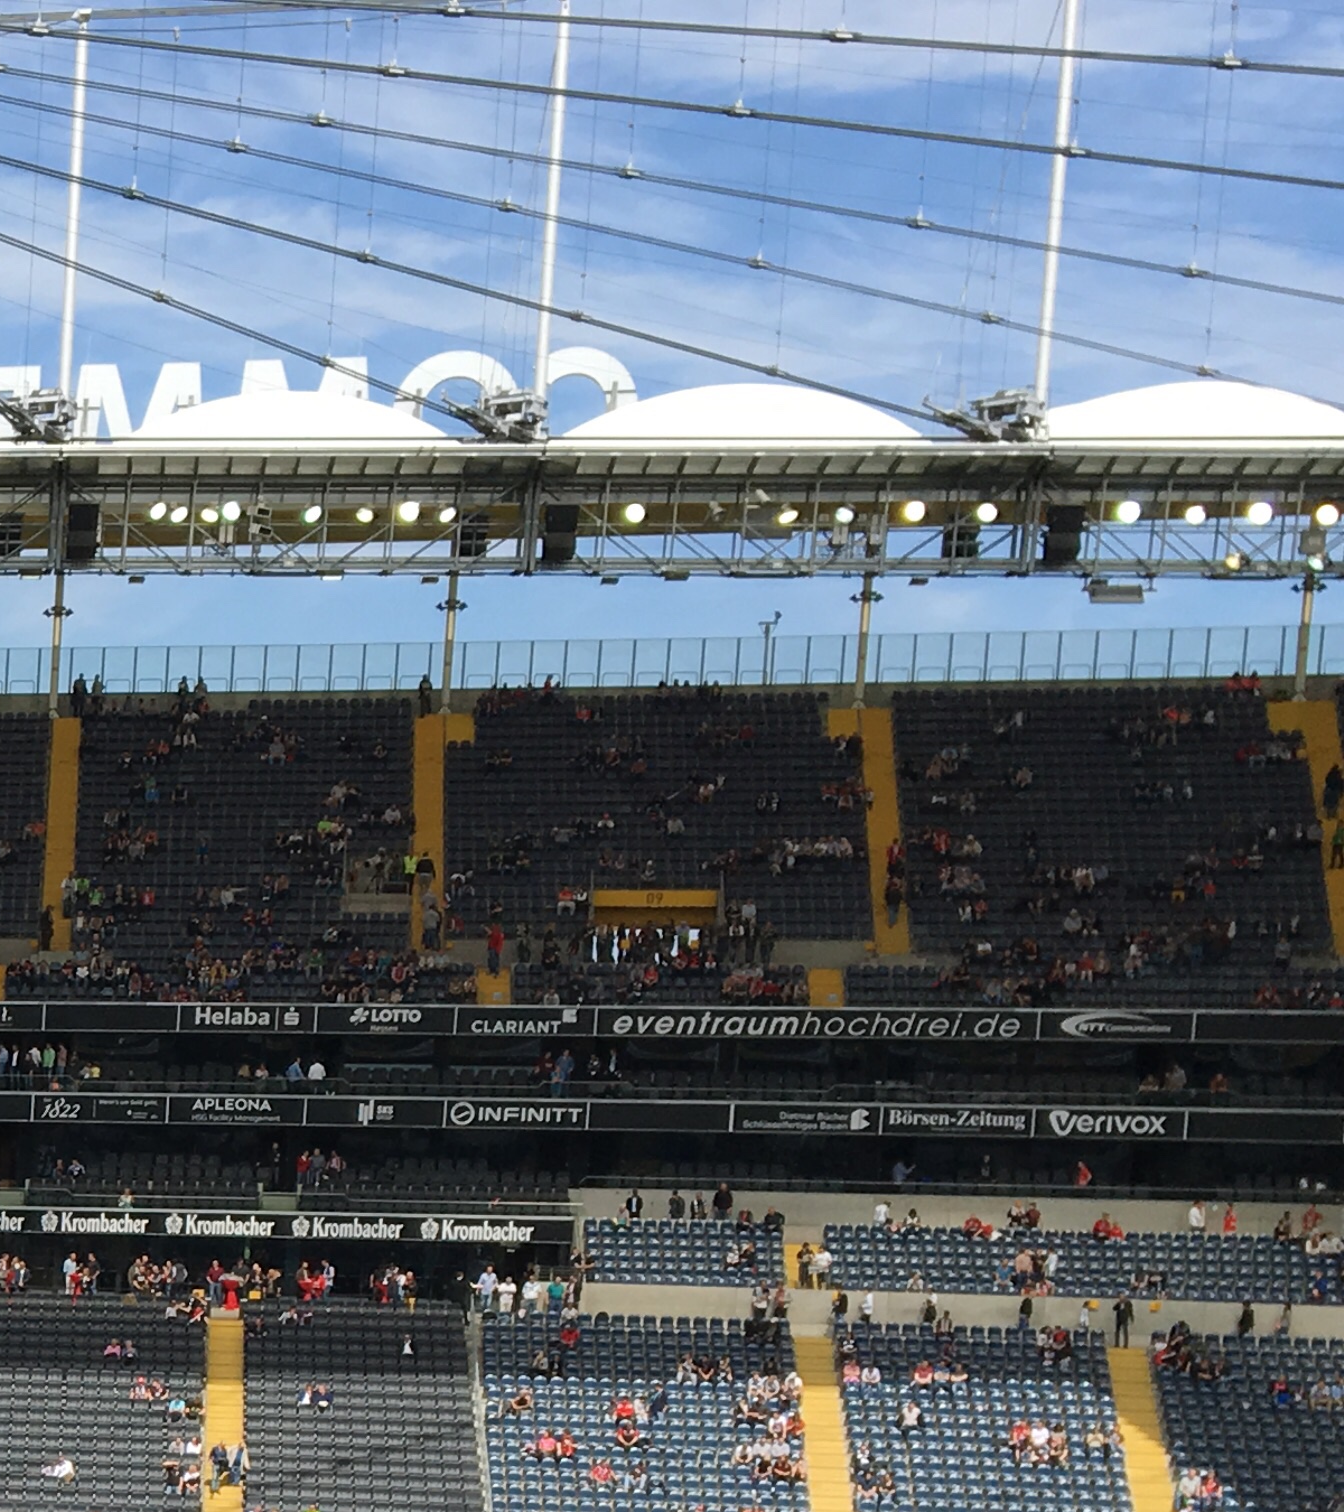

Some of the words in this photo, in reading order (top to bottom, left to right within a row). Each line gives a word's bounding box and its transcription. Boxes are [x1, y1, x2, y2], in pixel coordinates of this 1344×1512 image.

[194, 1006, 271, 1026] Helaba
[371, 1009, 422, 1023] LOTTO
[471, 1020, 562, 1033] CLARIANT
[612, 1011, 1021, 1039] eventraumhochdrei.de
[192, 1098, 272, 1111] APLEONA
[889, 1109, 1026, 1131] Börsen-Zeitung
[1049, 1110, 1167, 1136] Verivox
[61, 1211, 150, 1235] Krombacher
[185, 1214, 276, 1237] Krombacher
[311, 1216, 403, 1240] Krombacher
[442, 1219, 535, 1242] Krombacher
